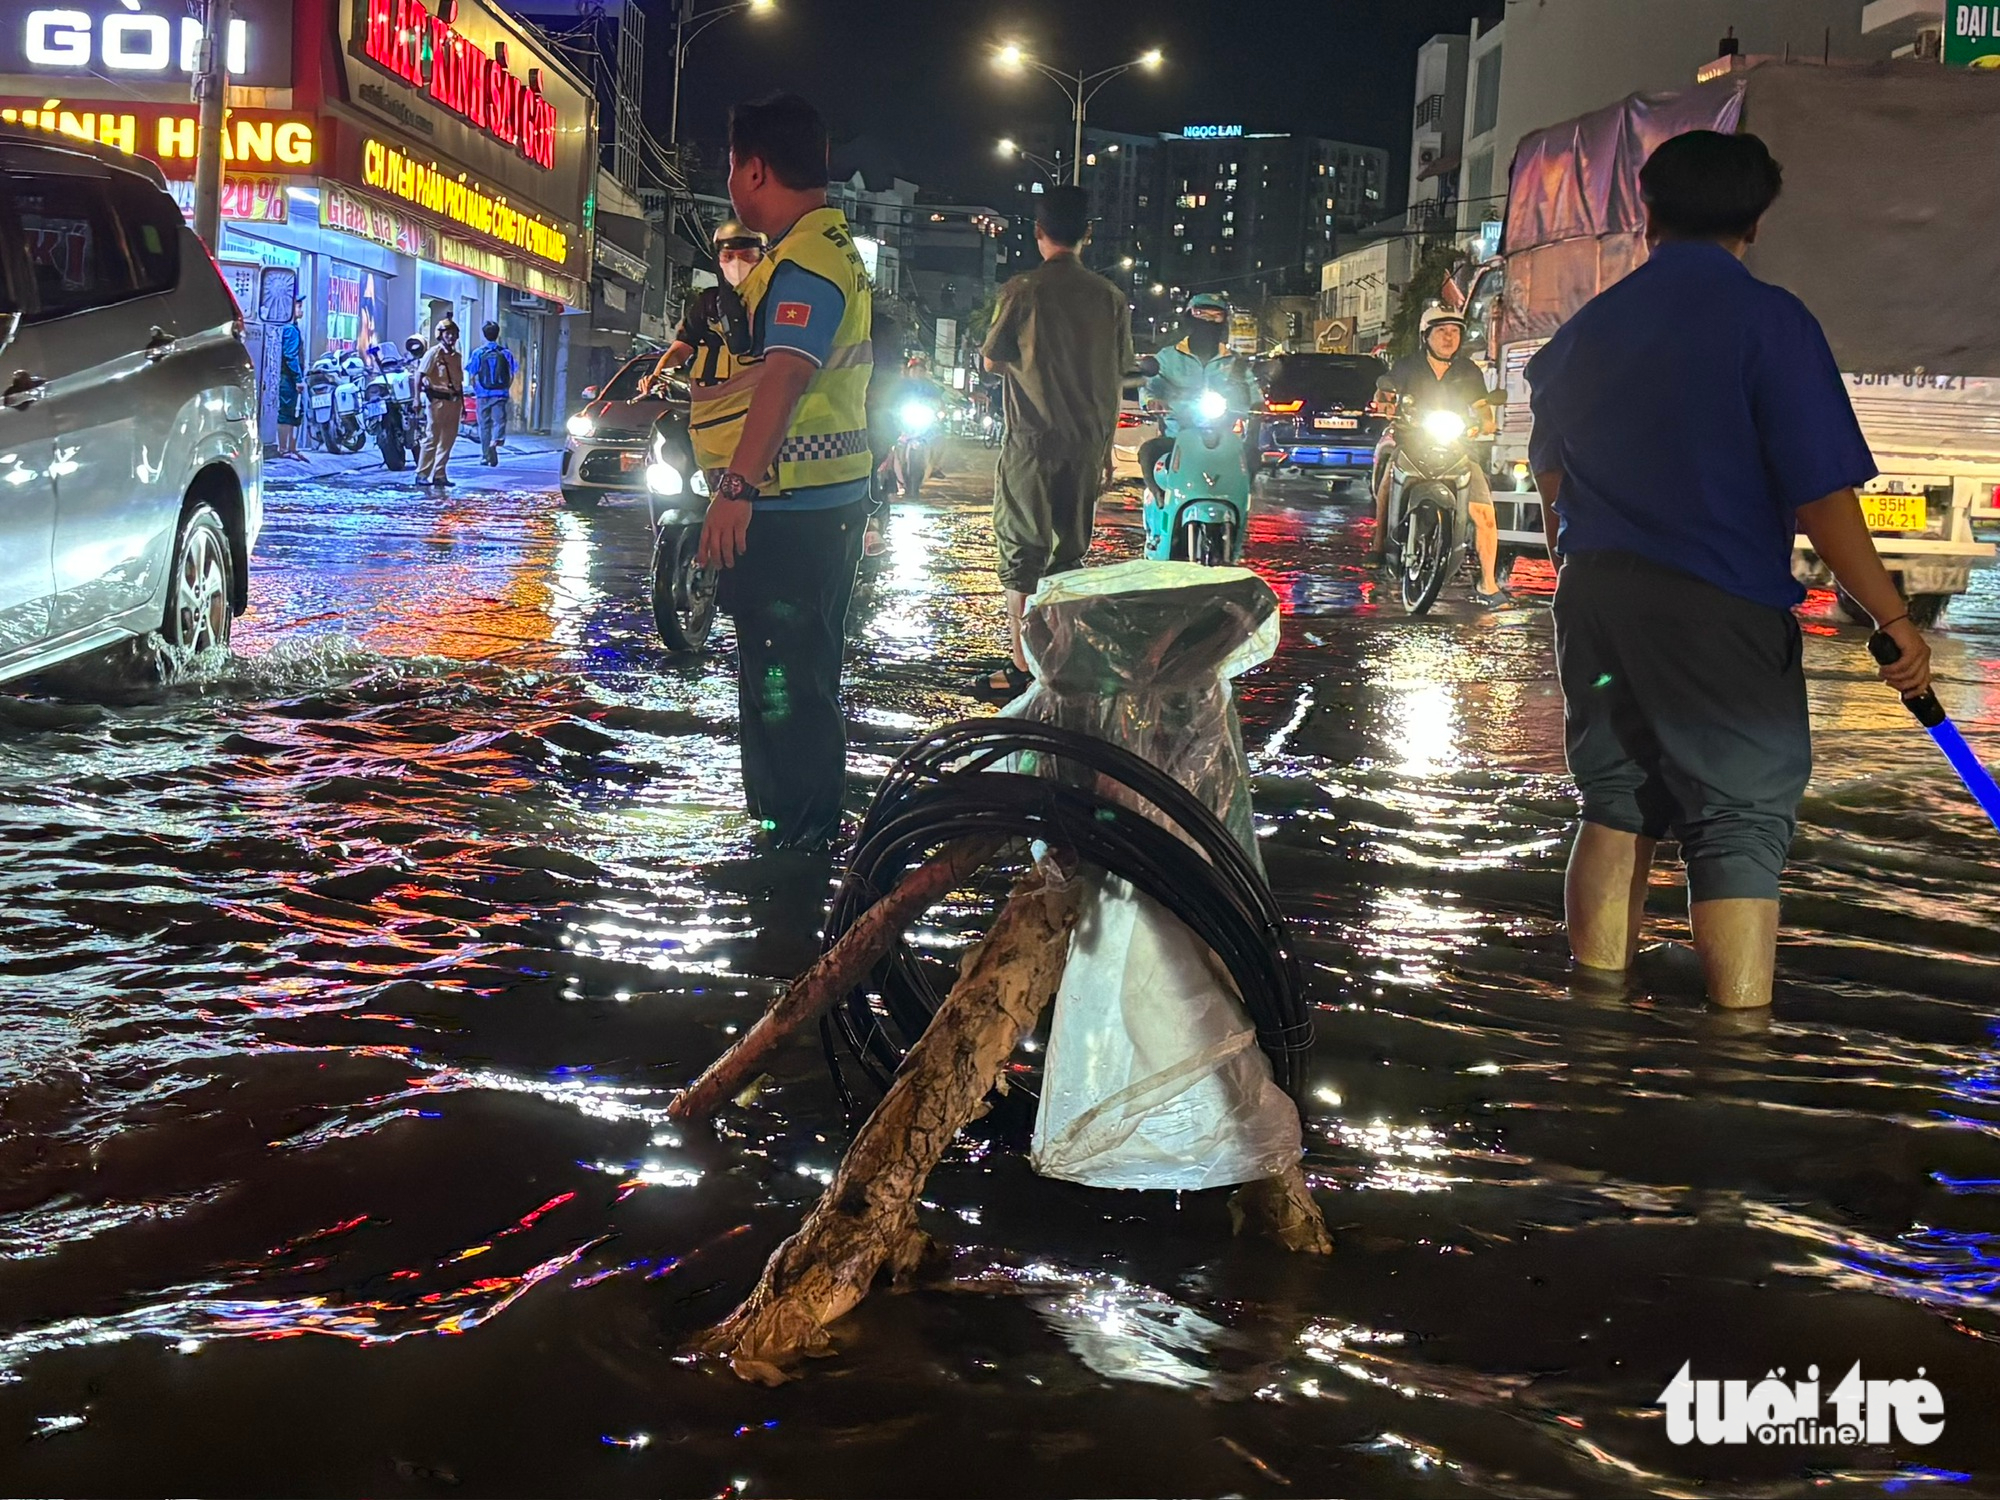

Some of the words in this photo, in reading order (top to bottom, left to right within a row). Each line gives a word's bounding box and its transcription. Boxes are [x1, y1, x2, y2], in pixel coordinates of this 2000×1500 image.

[1956, 5, 1988, 43] ĐẠI
[430, 0, 487, 128] KÍNH
[523, 68, 557, 171] GÒN
[1183, 126, 1217, 138] NGỌC
[1218, 125, 1242, 136] LAN
[221, 176, 285, 220] 20%
[1879, 498, 1907, 511] 95H
[1867, 513, 1917, 528] 004.21
